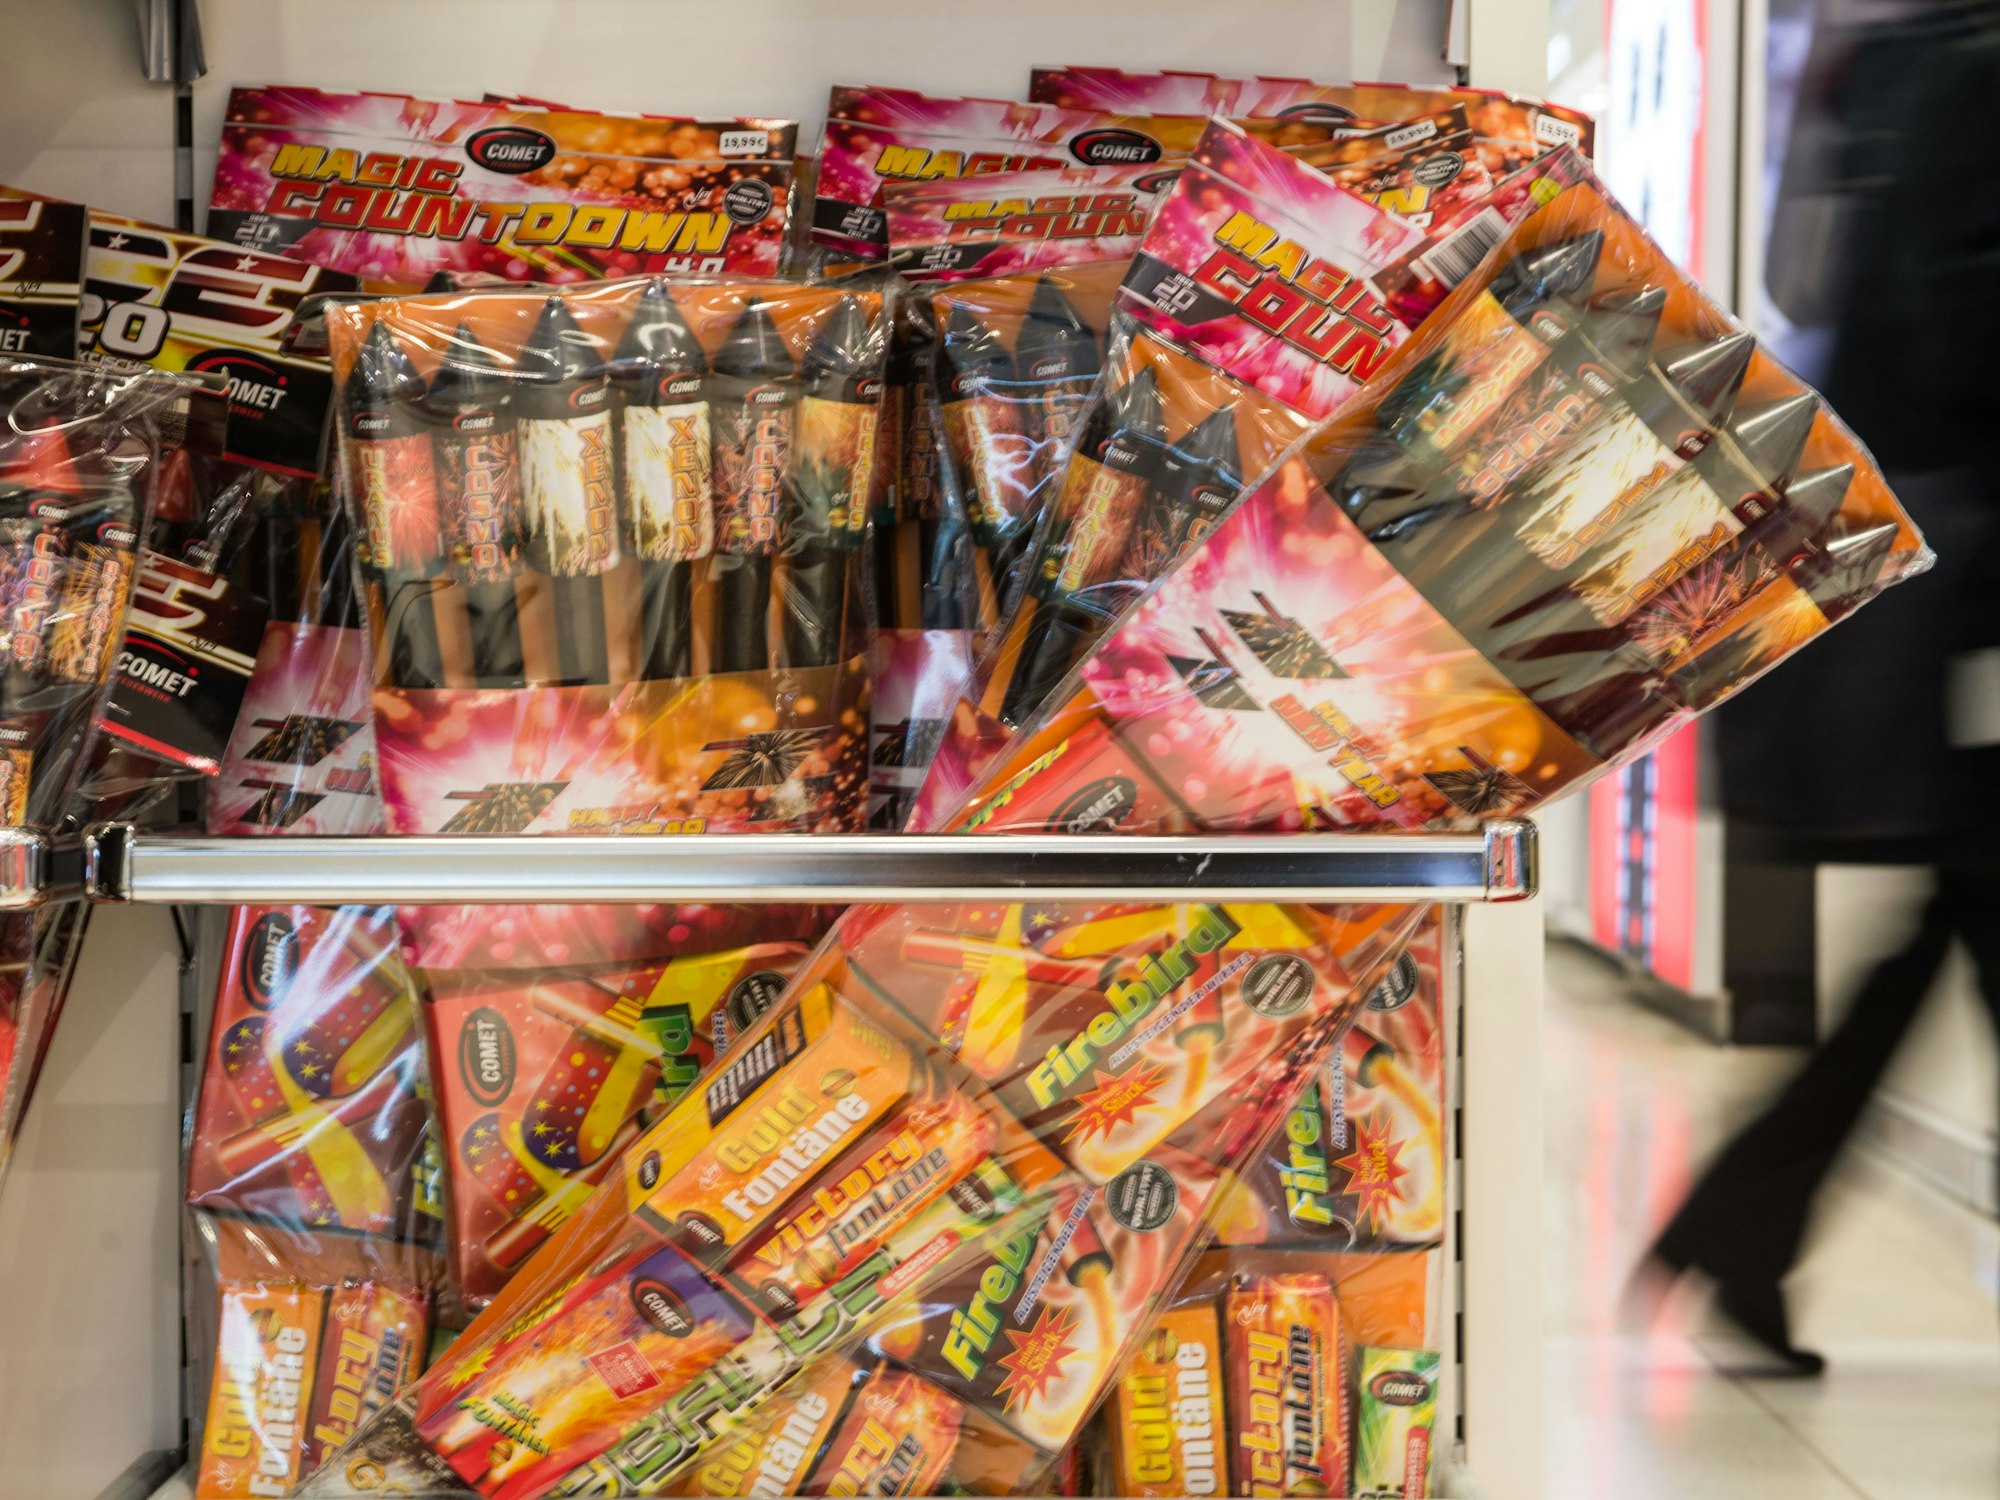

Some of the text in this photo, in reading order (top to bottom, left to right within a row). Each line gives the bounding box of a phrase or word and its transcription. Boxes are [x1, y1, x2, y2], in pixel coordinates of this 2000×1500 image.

[269, 143, 465, 195] MAGIC
[486, 142, 547, 162] COMET
[1090, 142, 1152, 162] COMET
[264, 179, 734, 255] COUNTDOWN
[840, 215, 881, 234] 20
[943, 192, 1139, 221] MAGIC
[234, 222, 277, 243] 20
[921, 248, 963, 266] 20
[1213, 208, 1400, 338] MAGIC
[1151, 274, 1199, 312] 20
[668, 379, 701, 394] COMET
[1036, 360, 1068, 378] COMET
[1582, 370, 1616, 396] COMET
[228, 377, 288, 411] OMET
[755, 390, 787, 404] COMET
[357, 418, 392, 431] COMET
[460, 416, 495, 431] COMET
[1470, 393, 1588, 497] COSMO
[1104, 444, 1139, 465] COMET
[577, 427, 610, 559] XENON
[667, 416, 701, 552] XENON
[749, 418, 779, 541] COSMO
[37, 504, 71, 521] COMET
[464, 443, 499, 569] COSMO
[1545, 460, 1674, 571] XENON
[104, 526, 137, 545] COMET
[1598, 521, 1733, 628] XENON
[115, 650, 199, 698] COMET
[1268, 692, 1341, 753] NEW
[1310, 699, 1388, 763] HAPPY
[1327, 744, 1401, 810] YEAR
[1066, 784, 1126, 834] COMET
[1024, 903, 1243, 1111] Firebird
[477, 1019, 502, 1084] COMET
[714, 1080, 818, 1175] Gold
[1088, 1080, 1147, 1128] 2 Stück
[720, 1091, 872, 1223] Fontäne
[1371, 1137, 1389, 1202] 2 Stück
[953, 1180, 993, 1219] COMET
[686, 1218, 722, 1245] COMET
[641, 1291, 689, 1333] COMET
[765, 1284, 796, 1311] COMET
[1025, 1330, 1064, 1391] 2 Stück
[250, 1326, 309, 1497] Fontäne
[491, 1388, 540, 1430] MAGIC
[1282, 1323, 1324, 1477] fontäne
[1382, 1383, 1425, 1398] COMET
[1126, 1374, 1175, 1483] Gold
